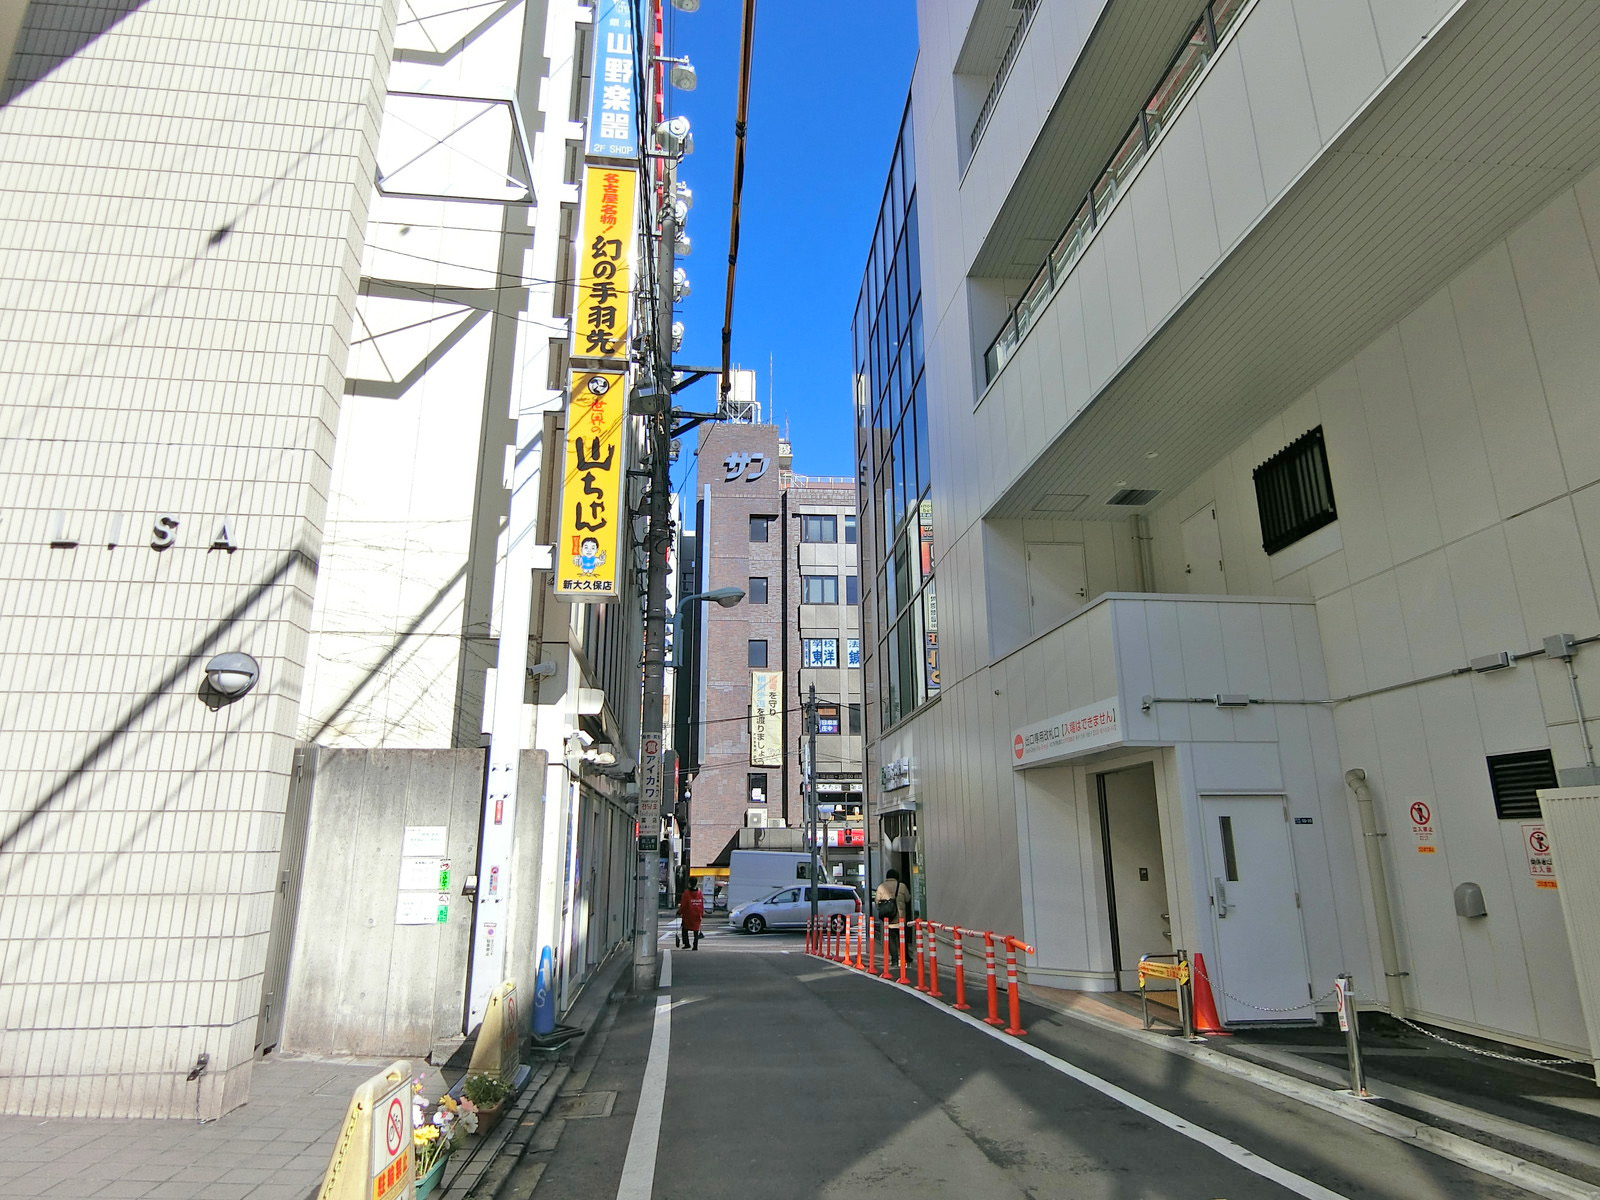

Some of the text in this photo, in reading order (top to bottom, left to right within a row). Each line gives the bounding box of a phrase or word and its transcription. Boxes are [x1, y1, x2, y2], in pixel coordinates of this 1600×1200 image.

[601, 32, 633, 140] 山野楽器
[594, 143, 633, 154] 2F SHOP
[586, 235, 622, 355] 幻の手羽先
[724, 452, 771, 482] サン
[562, 579, 613, 592] 新大久保店
[812, 650, 835, 665] 東洋
[645, 755, 656, 798] アイカワ
